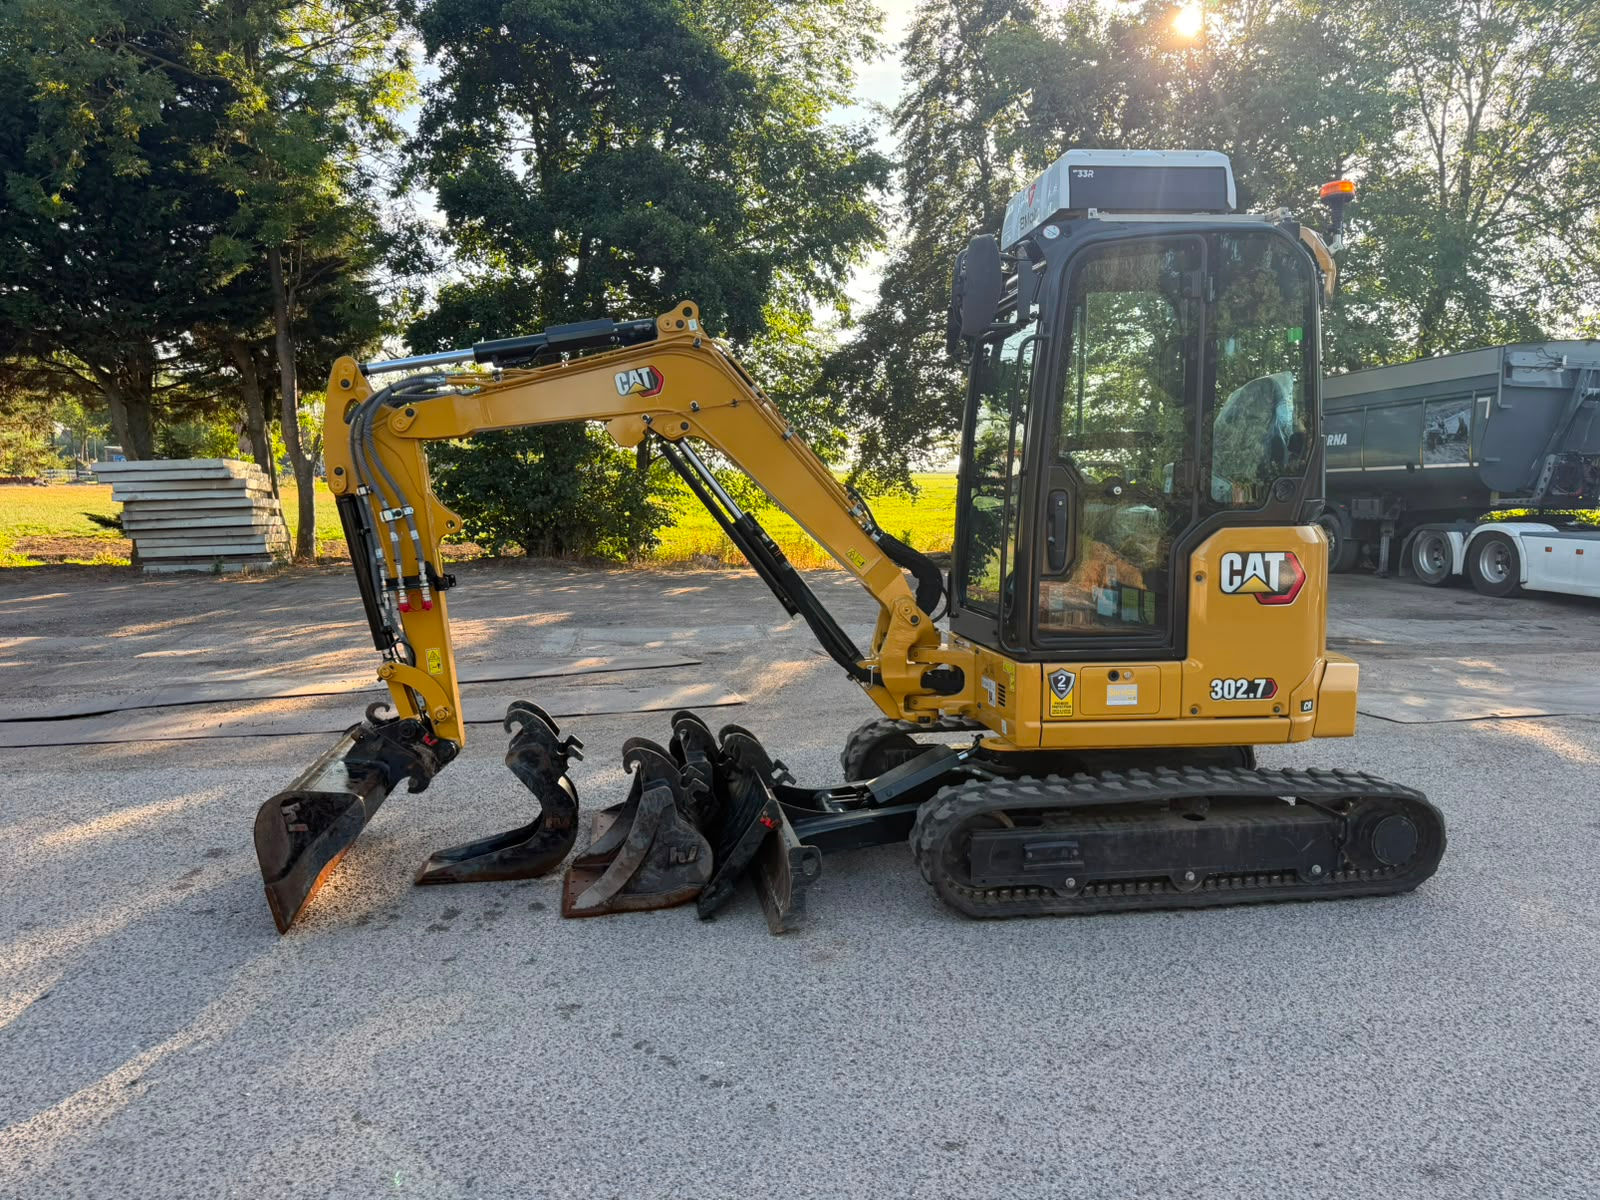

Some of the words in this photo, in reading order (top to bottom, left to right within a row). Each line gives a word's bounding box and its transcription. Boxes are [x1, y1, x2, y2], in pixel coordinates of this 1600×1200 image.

[615, 367, 651, 395] CAT
[1325, 432, 1348, 446] RNA
[1220, 552, 1285, 593] CAT
[1057, 675, 1066, 688] 2
[1210, 678, 1267, 699] 302.7
